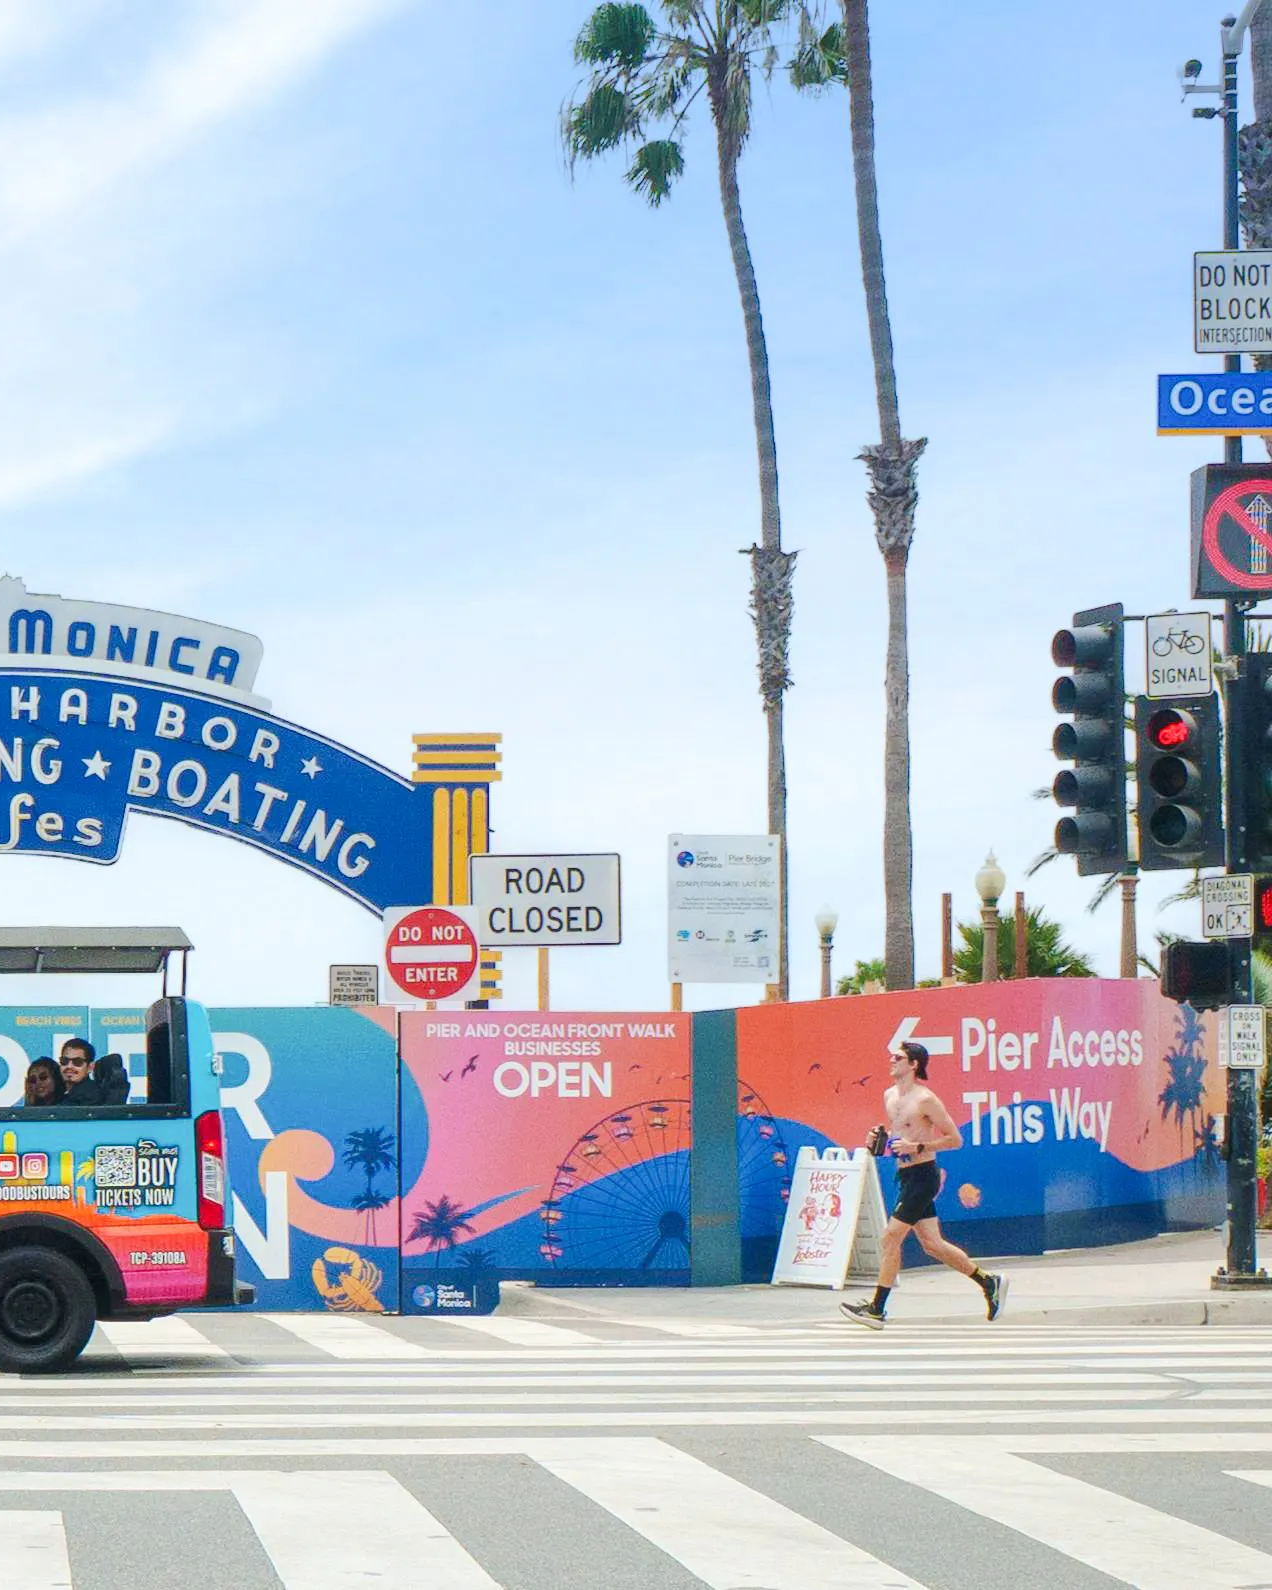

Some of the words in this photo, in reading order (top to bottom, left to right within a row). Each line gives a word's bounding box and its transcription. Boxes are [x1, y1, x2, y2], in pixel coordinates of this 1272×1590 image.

[1200, 264, 1225, 287] DO
[1233, 264, 1271, 287] NOT
[1200, 297, 1271, 320] BLOCK
[8, 608, 240, 681] MONICA
[1152, 666, 1208, 684] SIGNAL
[10, 685, 281, 769] HARBOR
[127, 748, 377, 878] BOATING
[504, 867, 585, 894] ROAD
[488, 906, 603, 934] CLOSED
[1208, 913, 1223, 930] OK
[398, 925, 422, 943] DO
[431, 925, 464, 941] NOT
[405, 967, 458, 983] ENTER
[1232, 1011, 1261, 1021] CROSS
[425, 1023, 461, 1039] PIER
[463, 1023, 501, 1039] AND
[503, 1023, 566, 1039] OCEAN
[567, 1023, 625, 1039] FRONT
[627, 1023, 676, 1039] WALK
[1237, 1031, 1257, 1041] WALK
[503, 1041, 602, 1056] BUSINESSES
[961, 1015, 1039, 1072] Pier
[1046, 1015, 1144, 1069] Access
[1232, 1041, 1261, 1052] SIGNAL
[1236, 1051, 1257, 1062] ONLY
[492, 1060, 613, 1099] OPEN
[962, 1090, 1045, 1147] This
[1050, 1087, 1114, 1153] Way
[138, 1157, 178, 1187] BUY
[95, 1187, 141, 1206] TICKETS
[144, 1188, 175, 1206] NOW
[436, 1289, 465, 1299] Santa
[436, 1299, 473, 1308] Monica
